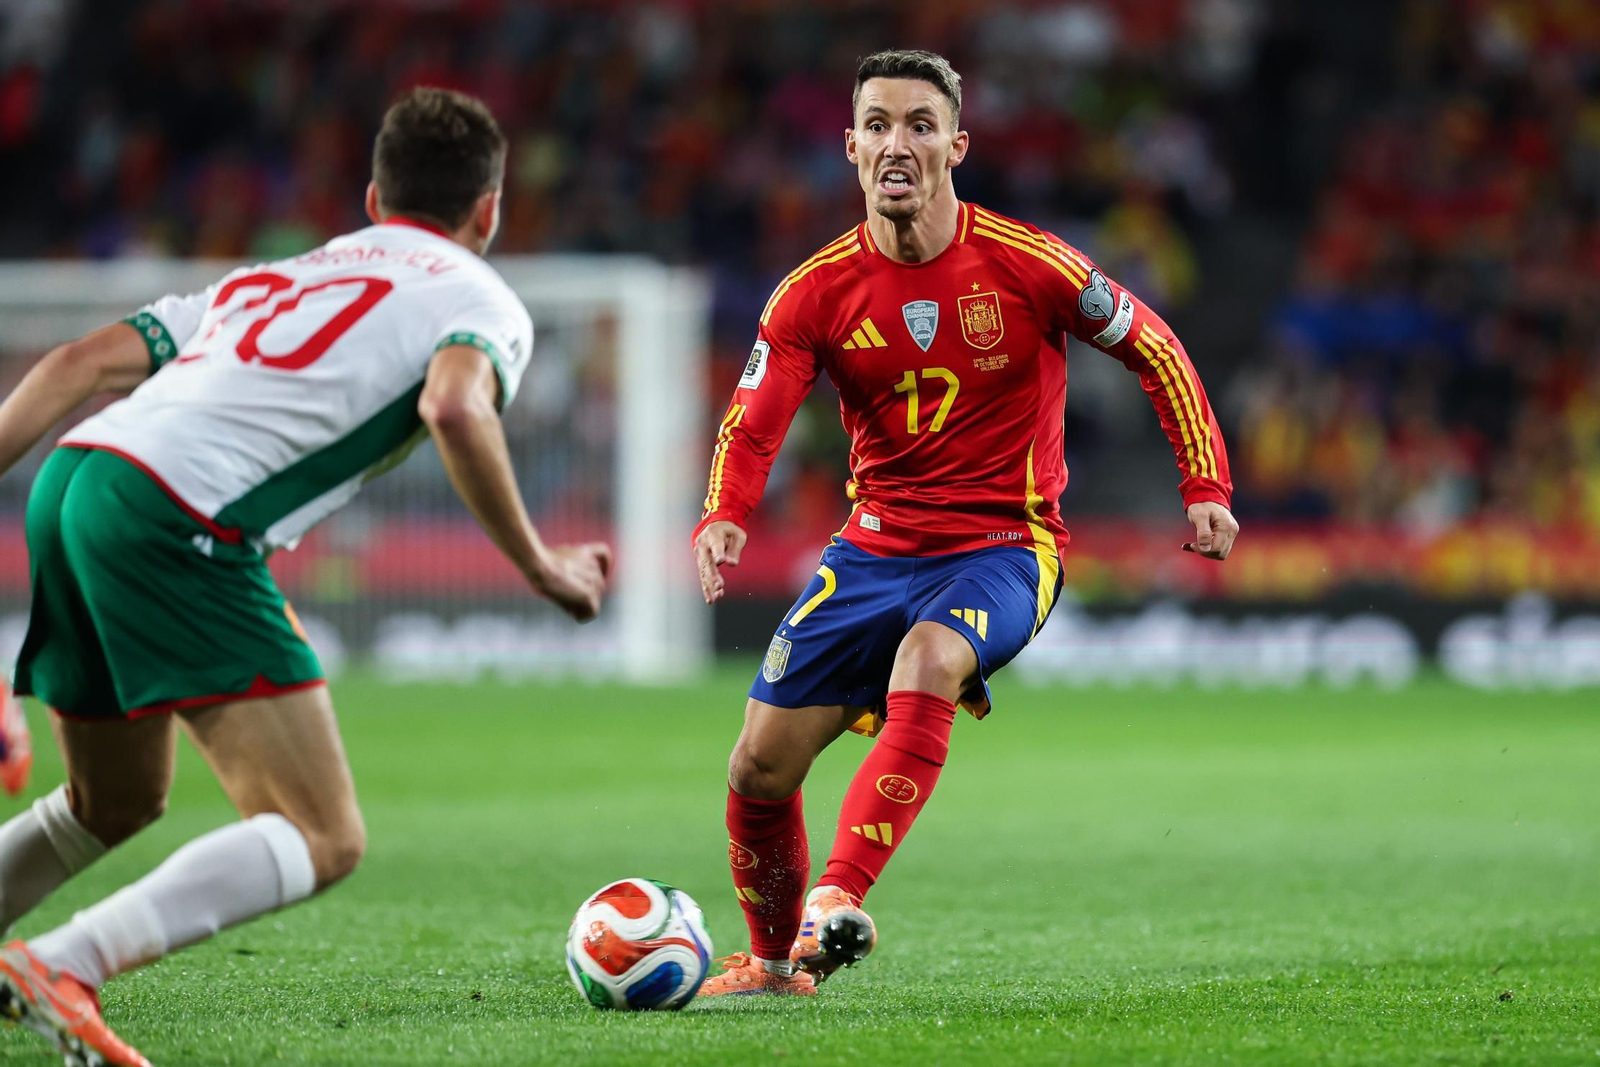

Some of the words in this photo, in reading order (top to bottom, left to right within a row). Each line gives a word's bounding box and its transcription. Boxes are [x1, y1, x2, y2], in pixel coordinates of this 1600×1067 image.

[178, 273, 394, 373] 20
[906, 312, 935, 320] CHAMPIONS
[894, 367, 960, 434] 17
